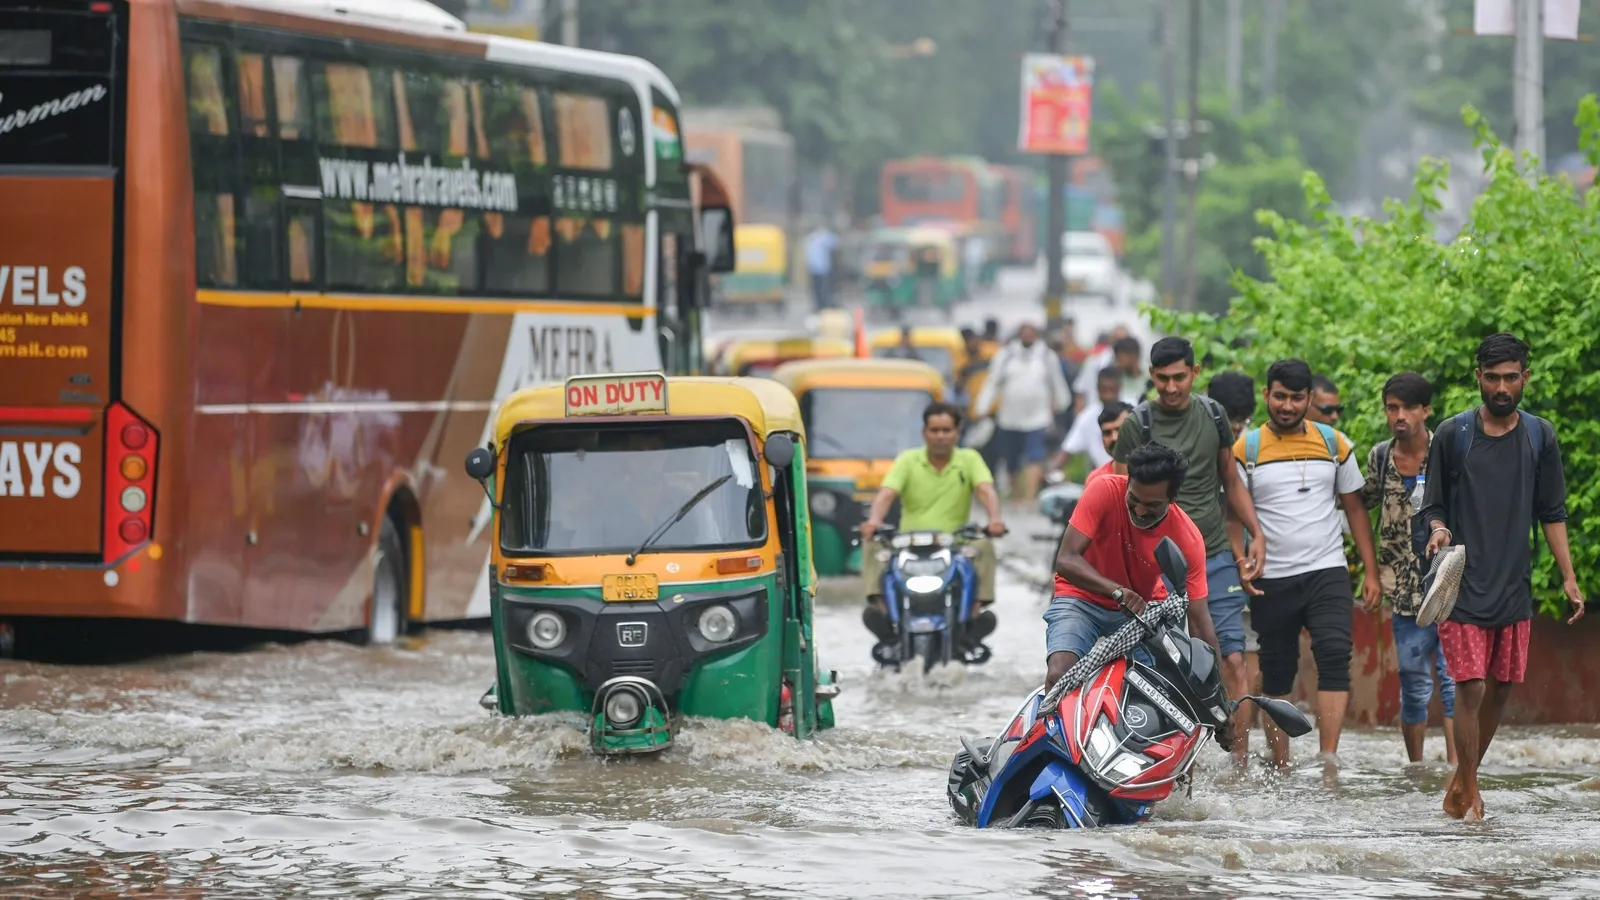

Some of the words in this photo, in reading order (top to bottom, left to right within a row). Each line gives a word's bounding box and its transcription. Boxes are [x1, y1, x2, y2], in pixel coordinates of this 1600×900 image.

[0, 84, 107, 134] urman
[318, 151, 519, 212] www.mehratravels.com
[25, 312, 49, 326] New
[529, 325, 614, 381] MEHRA
[567, 385, 598, 408] ON
[605, 380, 664, 404] DUTY
[0, 441, 81, 499] AYS
[622, 630, 642, 642] RE
